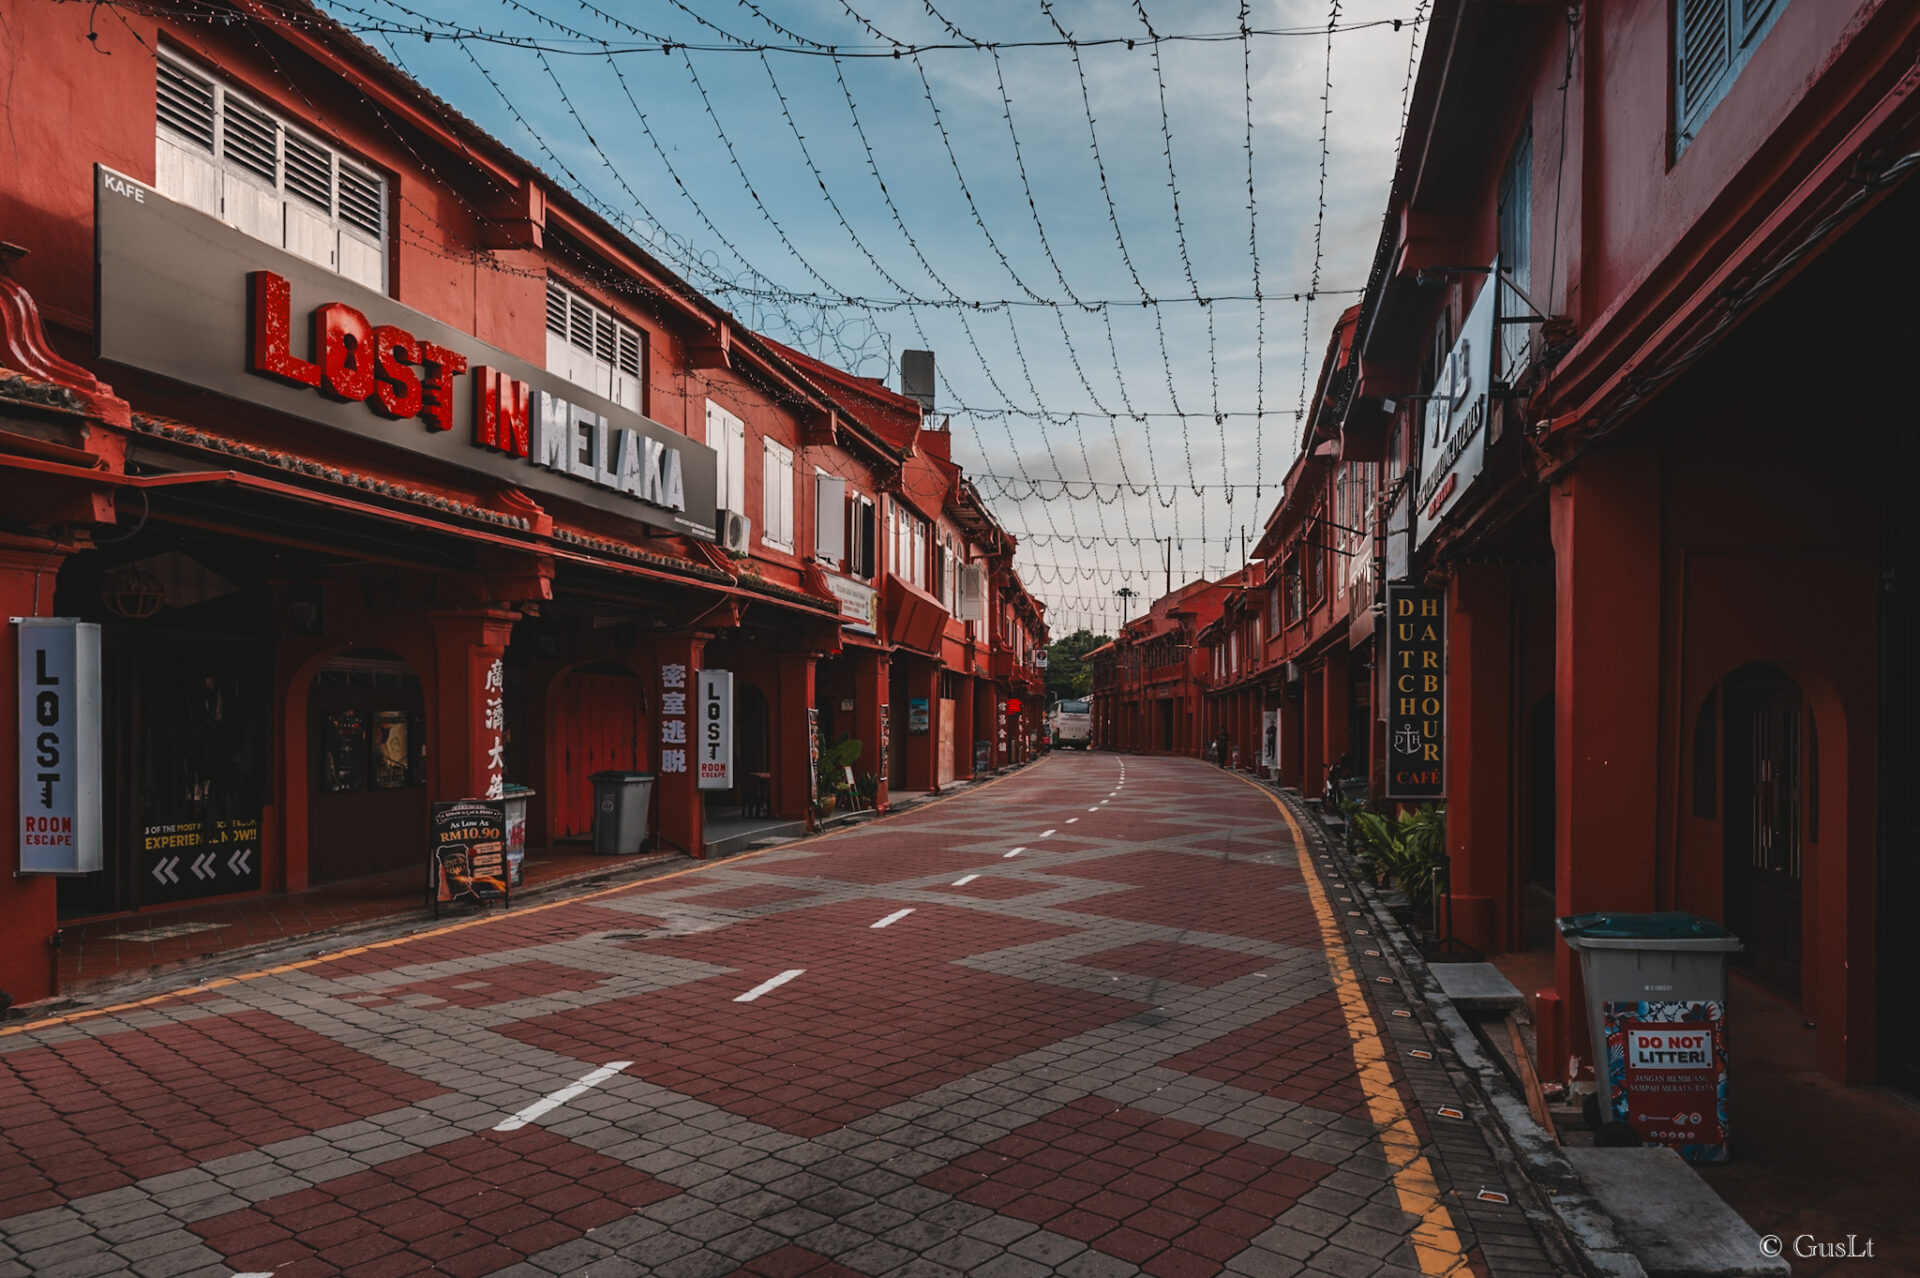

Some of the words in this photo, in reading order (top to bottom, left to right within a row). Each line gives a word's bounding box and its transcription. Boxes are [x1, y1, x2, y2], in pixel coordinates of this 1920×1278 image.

[104, 174, 145, 204] KAFE
[254, 270, 467, 431] LOST
[476, 364, 530, 458] IN
[533, 390, 686, 512] MELAKA
[1398, 599, 1416, 716] DUTCH
[1421, 599, 1440, 761] HARBOUR
[36, 649, 60, 809] LOST
[708, 682, 721, 760] LOST
[701, 763, 726, 772] ROOM
[25, 816, 72, 833] ROOM
[150, 826, 161, 834] OF
[162, 825, 177, 833] THE
[25, 834, 72, 846] ESCAPE
[440, 827, 500, 842] RM10.90
[1638, 1036, 1663, 1049] DO
[1668, 1036, 1704, 1049] NOT
[1638, 1051, 1706, 1064] LITTER!
